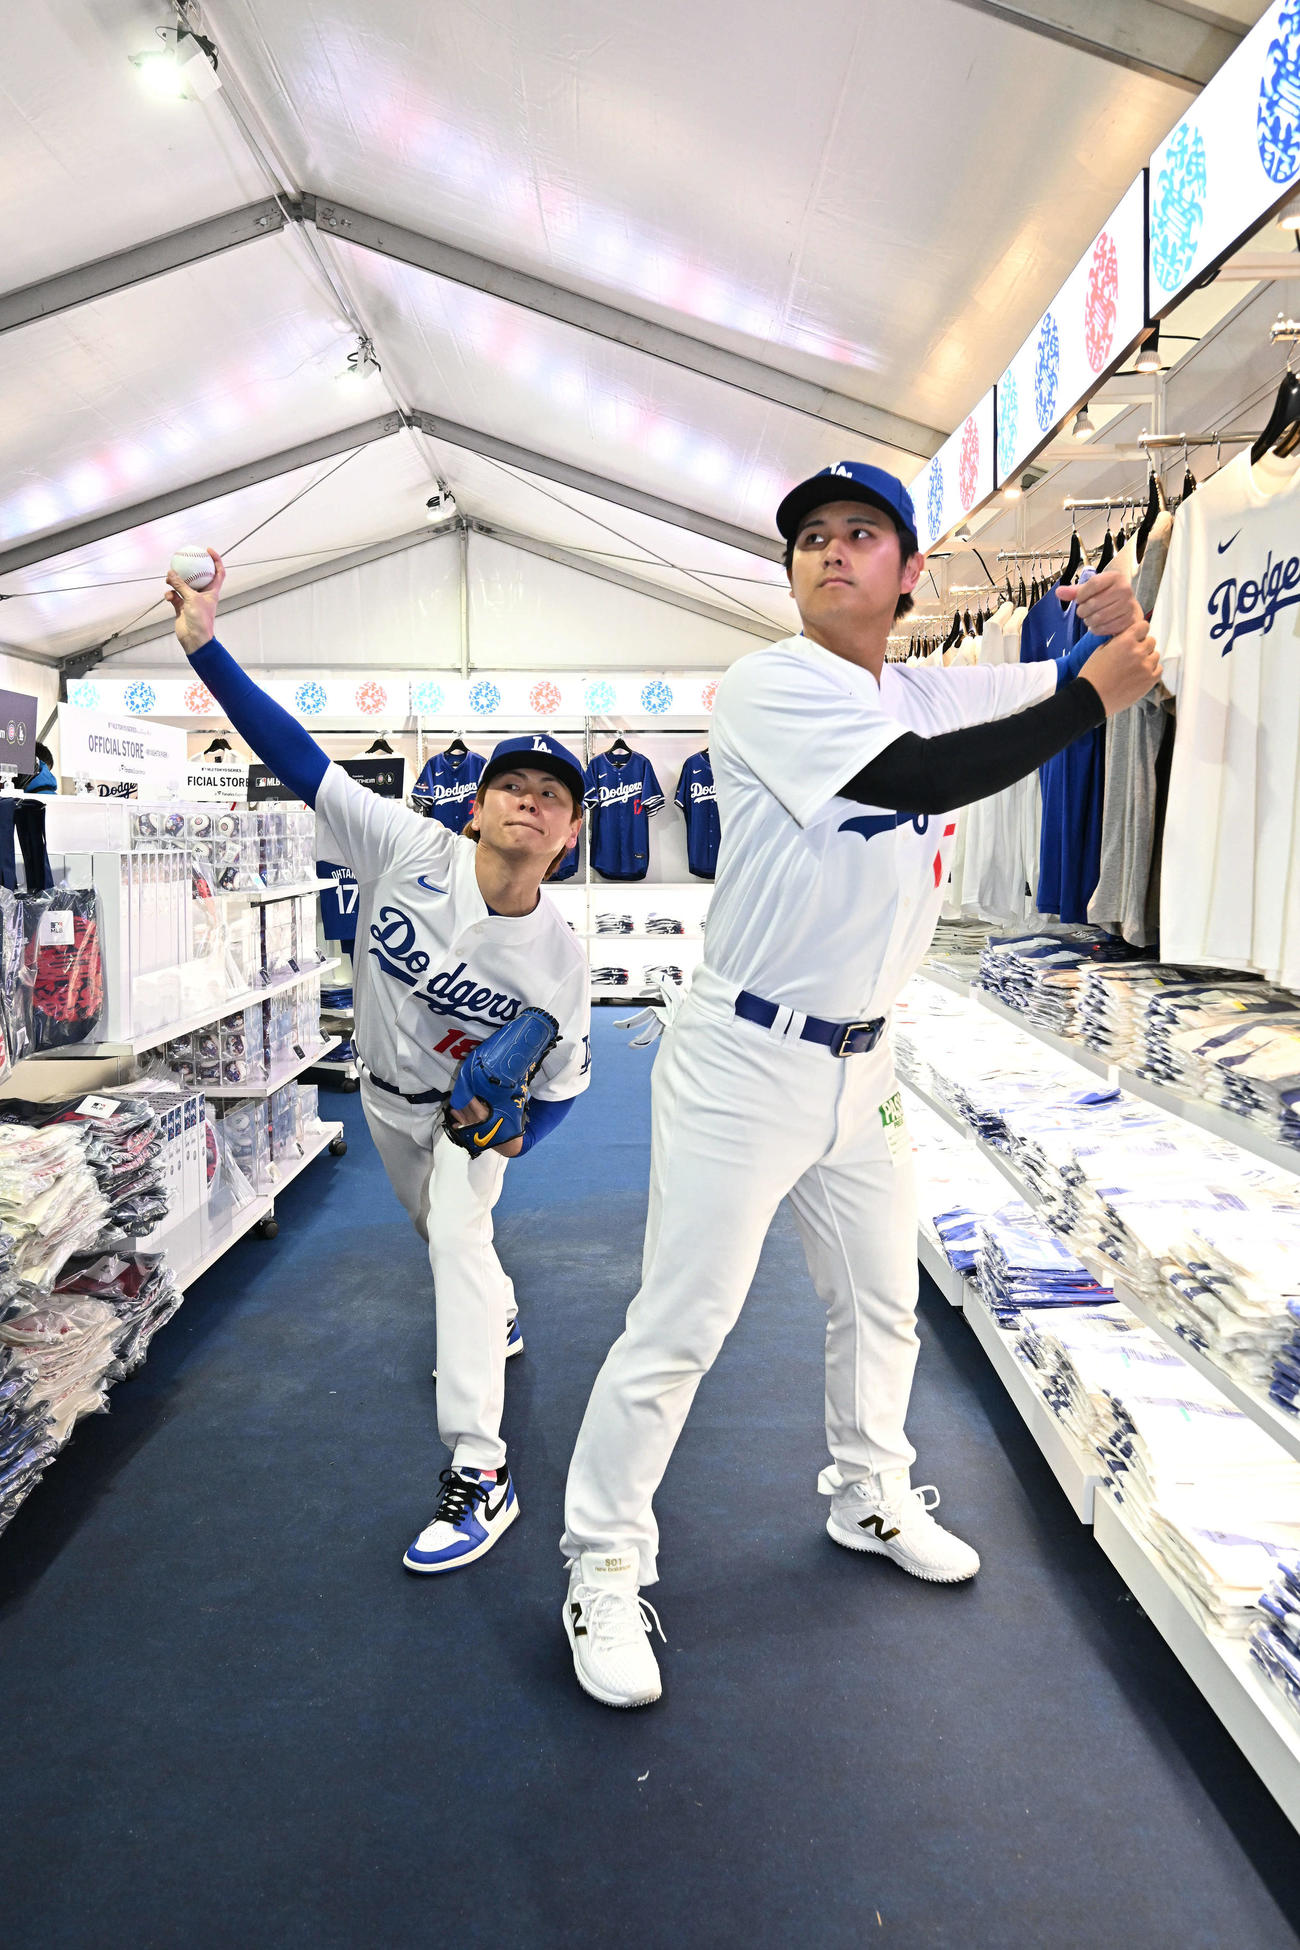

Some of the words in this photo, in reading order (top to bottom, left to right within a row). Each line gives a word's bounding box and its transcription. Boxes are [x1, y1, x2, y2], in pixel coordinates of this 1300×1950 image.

[88, 734, 121, 757] OFFICIAL
[121, 740, 144, 760] STORE
[531, 736, 552, 754] LA
[433, 782, 478, 805] Dodgers
[336, 884, 359, 914] 17
[369, 906, 522, 1028] Dodgers
